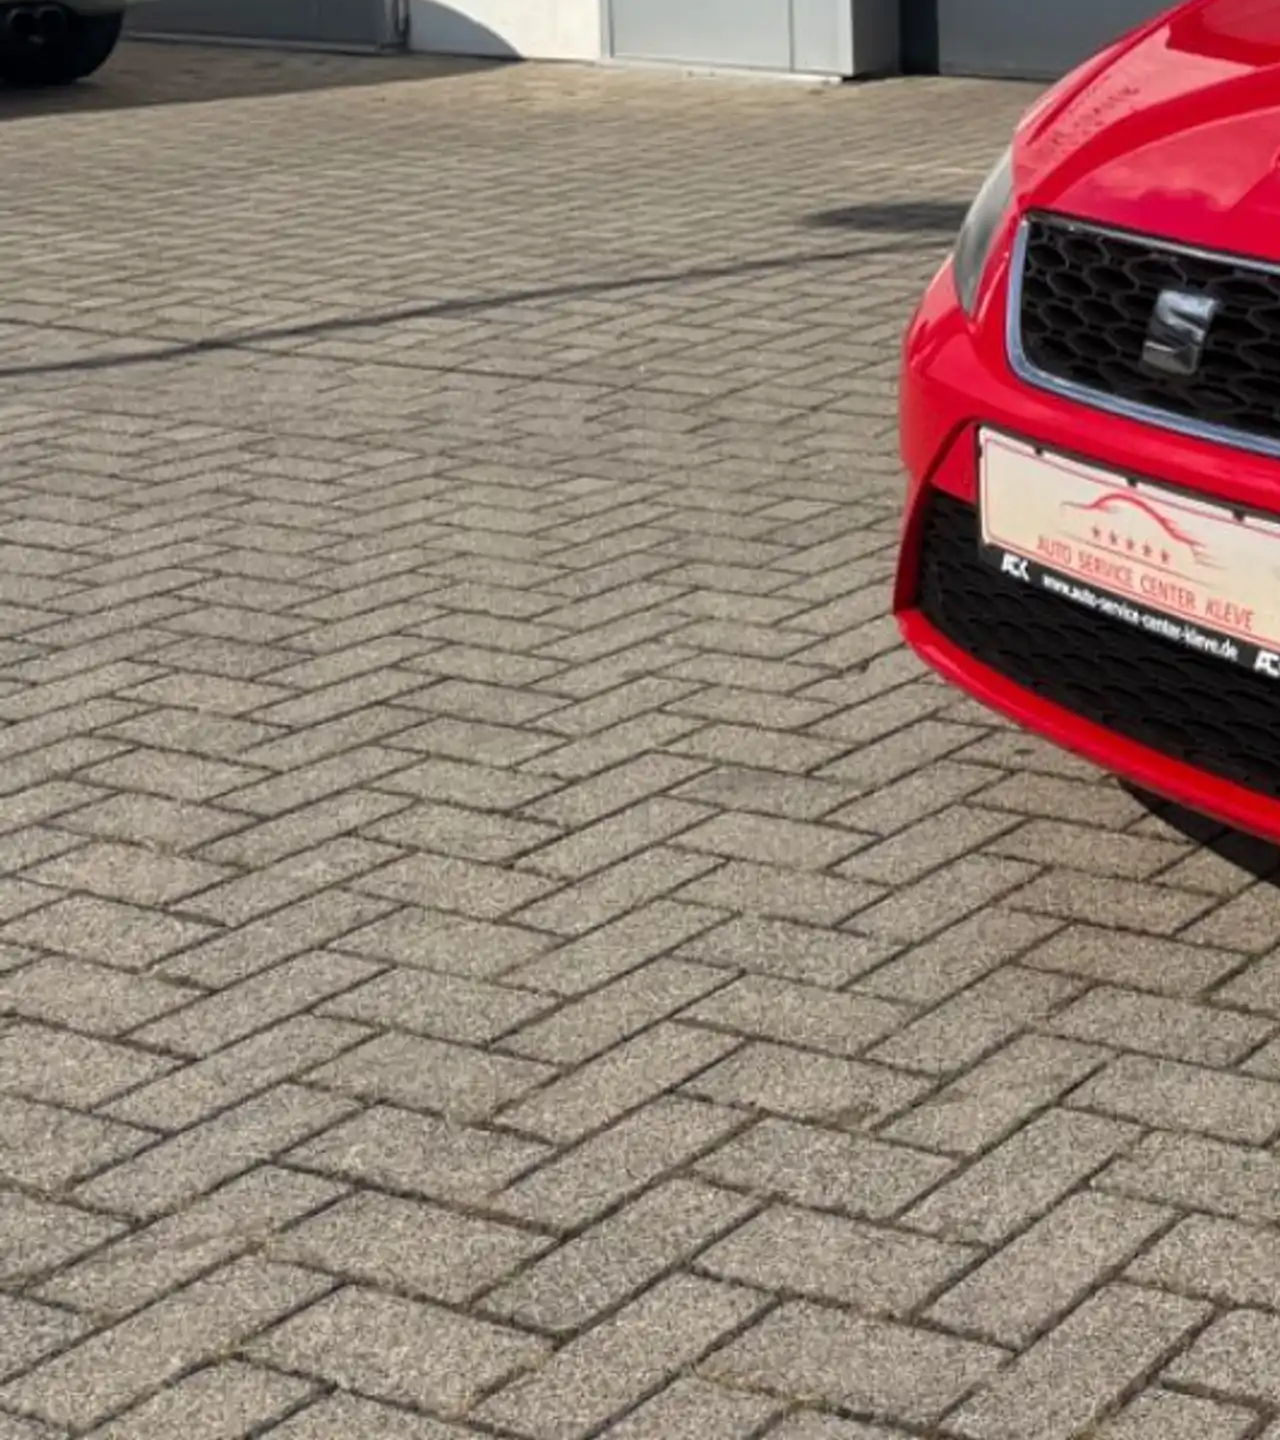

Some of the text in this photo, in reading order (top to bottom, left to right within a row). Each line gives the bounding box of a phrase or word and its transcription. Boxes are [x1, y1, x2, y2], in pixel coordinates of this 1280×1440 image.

[1036, 535, 1256, 631] AUTO SERVICE CENTER KLEVE
[1042, 573, 1239, 661] www.auto-service-center-kleve.de
